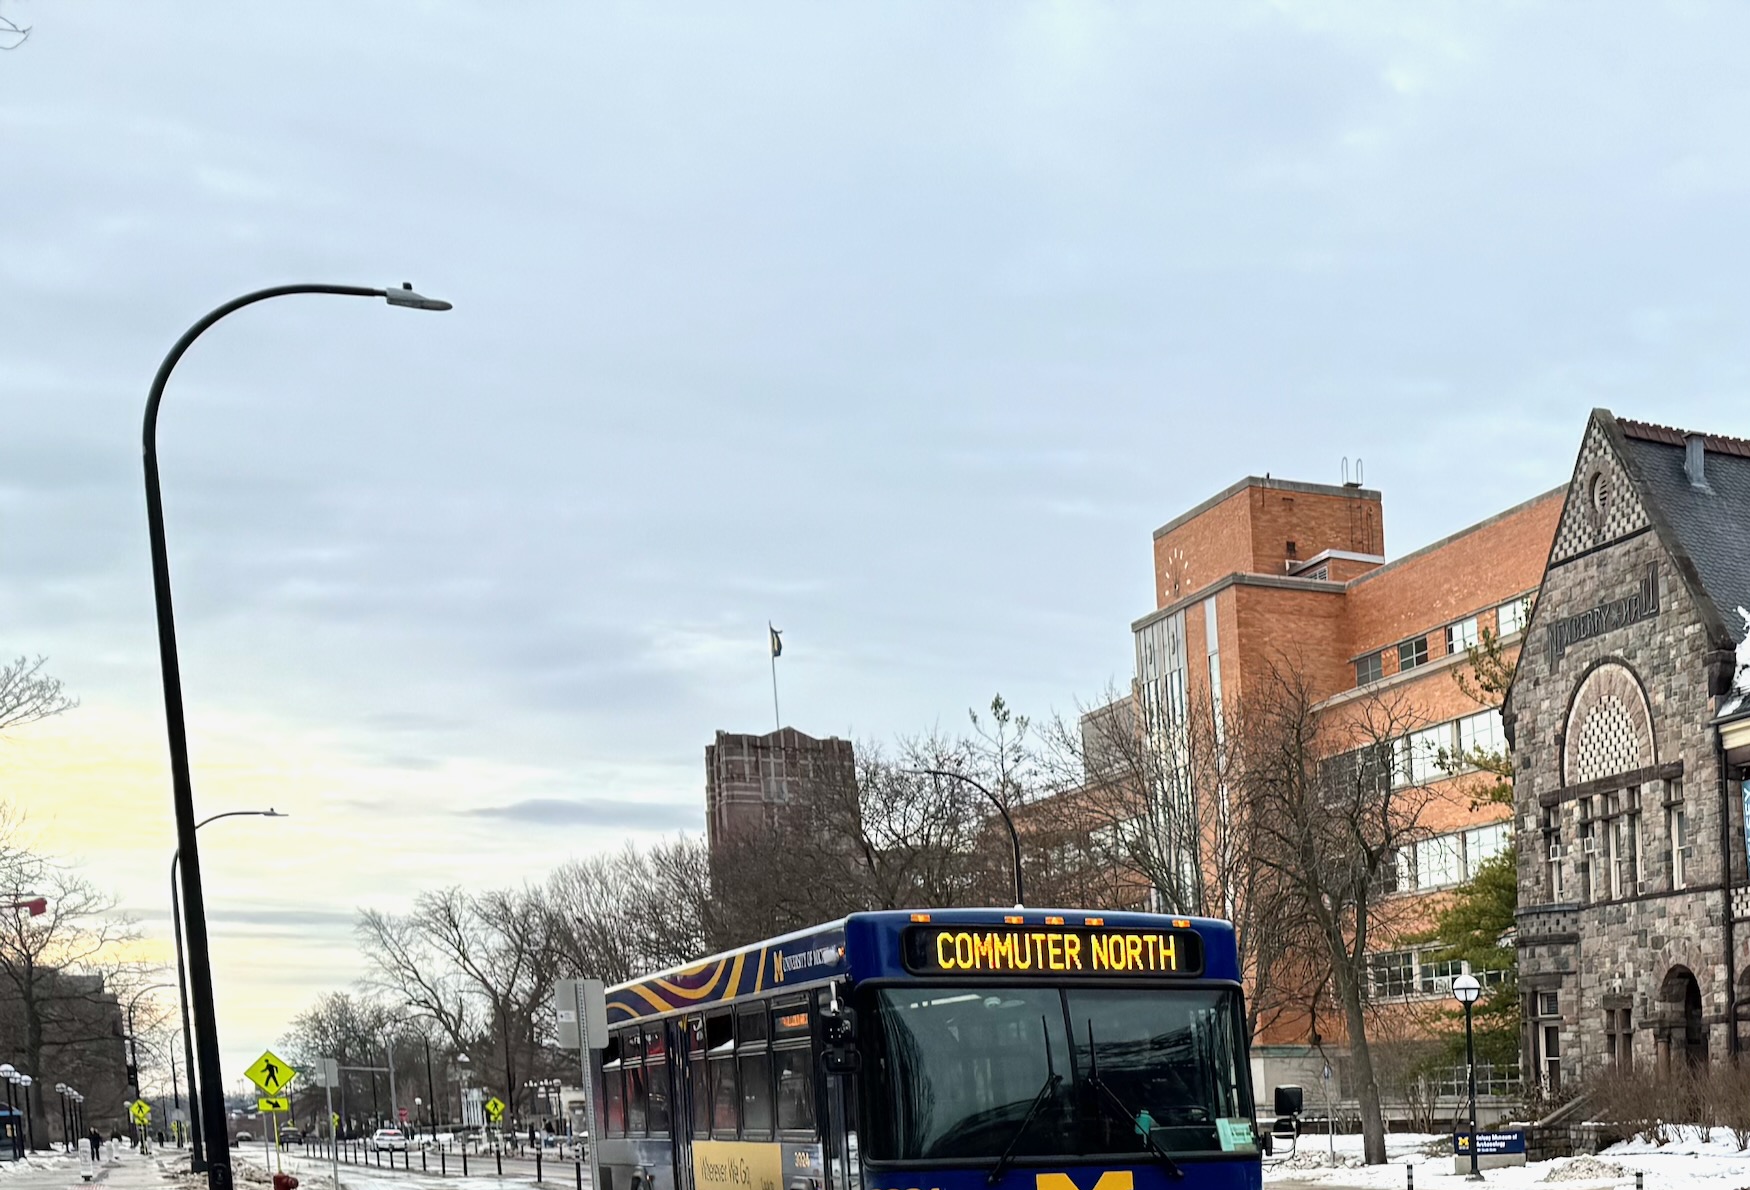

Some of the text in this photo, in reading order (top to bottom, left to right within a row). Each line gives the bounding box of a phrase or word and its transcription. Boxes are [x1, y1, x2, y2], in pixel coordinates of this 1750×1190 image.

[1548, 570, 1659, 666] NEWBERRY HALL
[936, 931, 1177, 971] COMMUTER NORTH
[700, 1156, 752, 1190] Wherever We Go,
